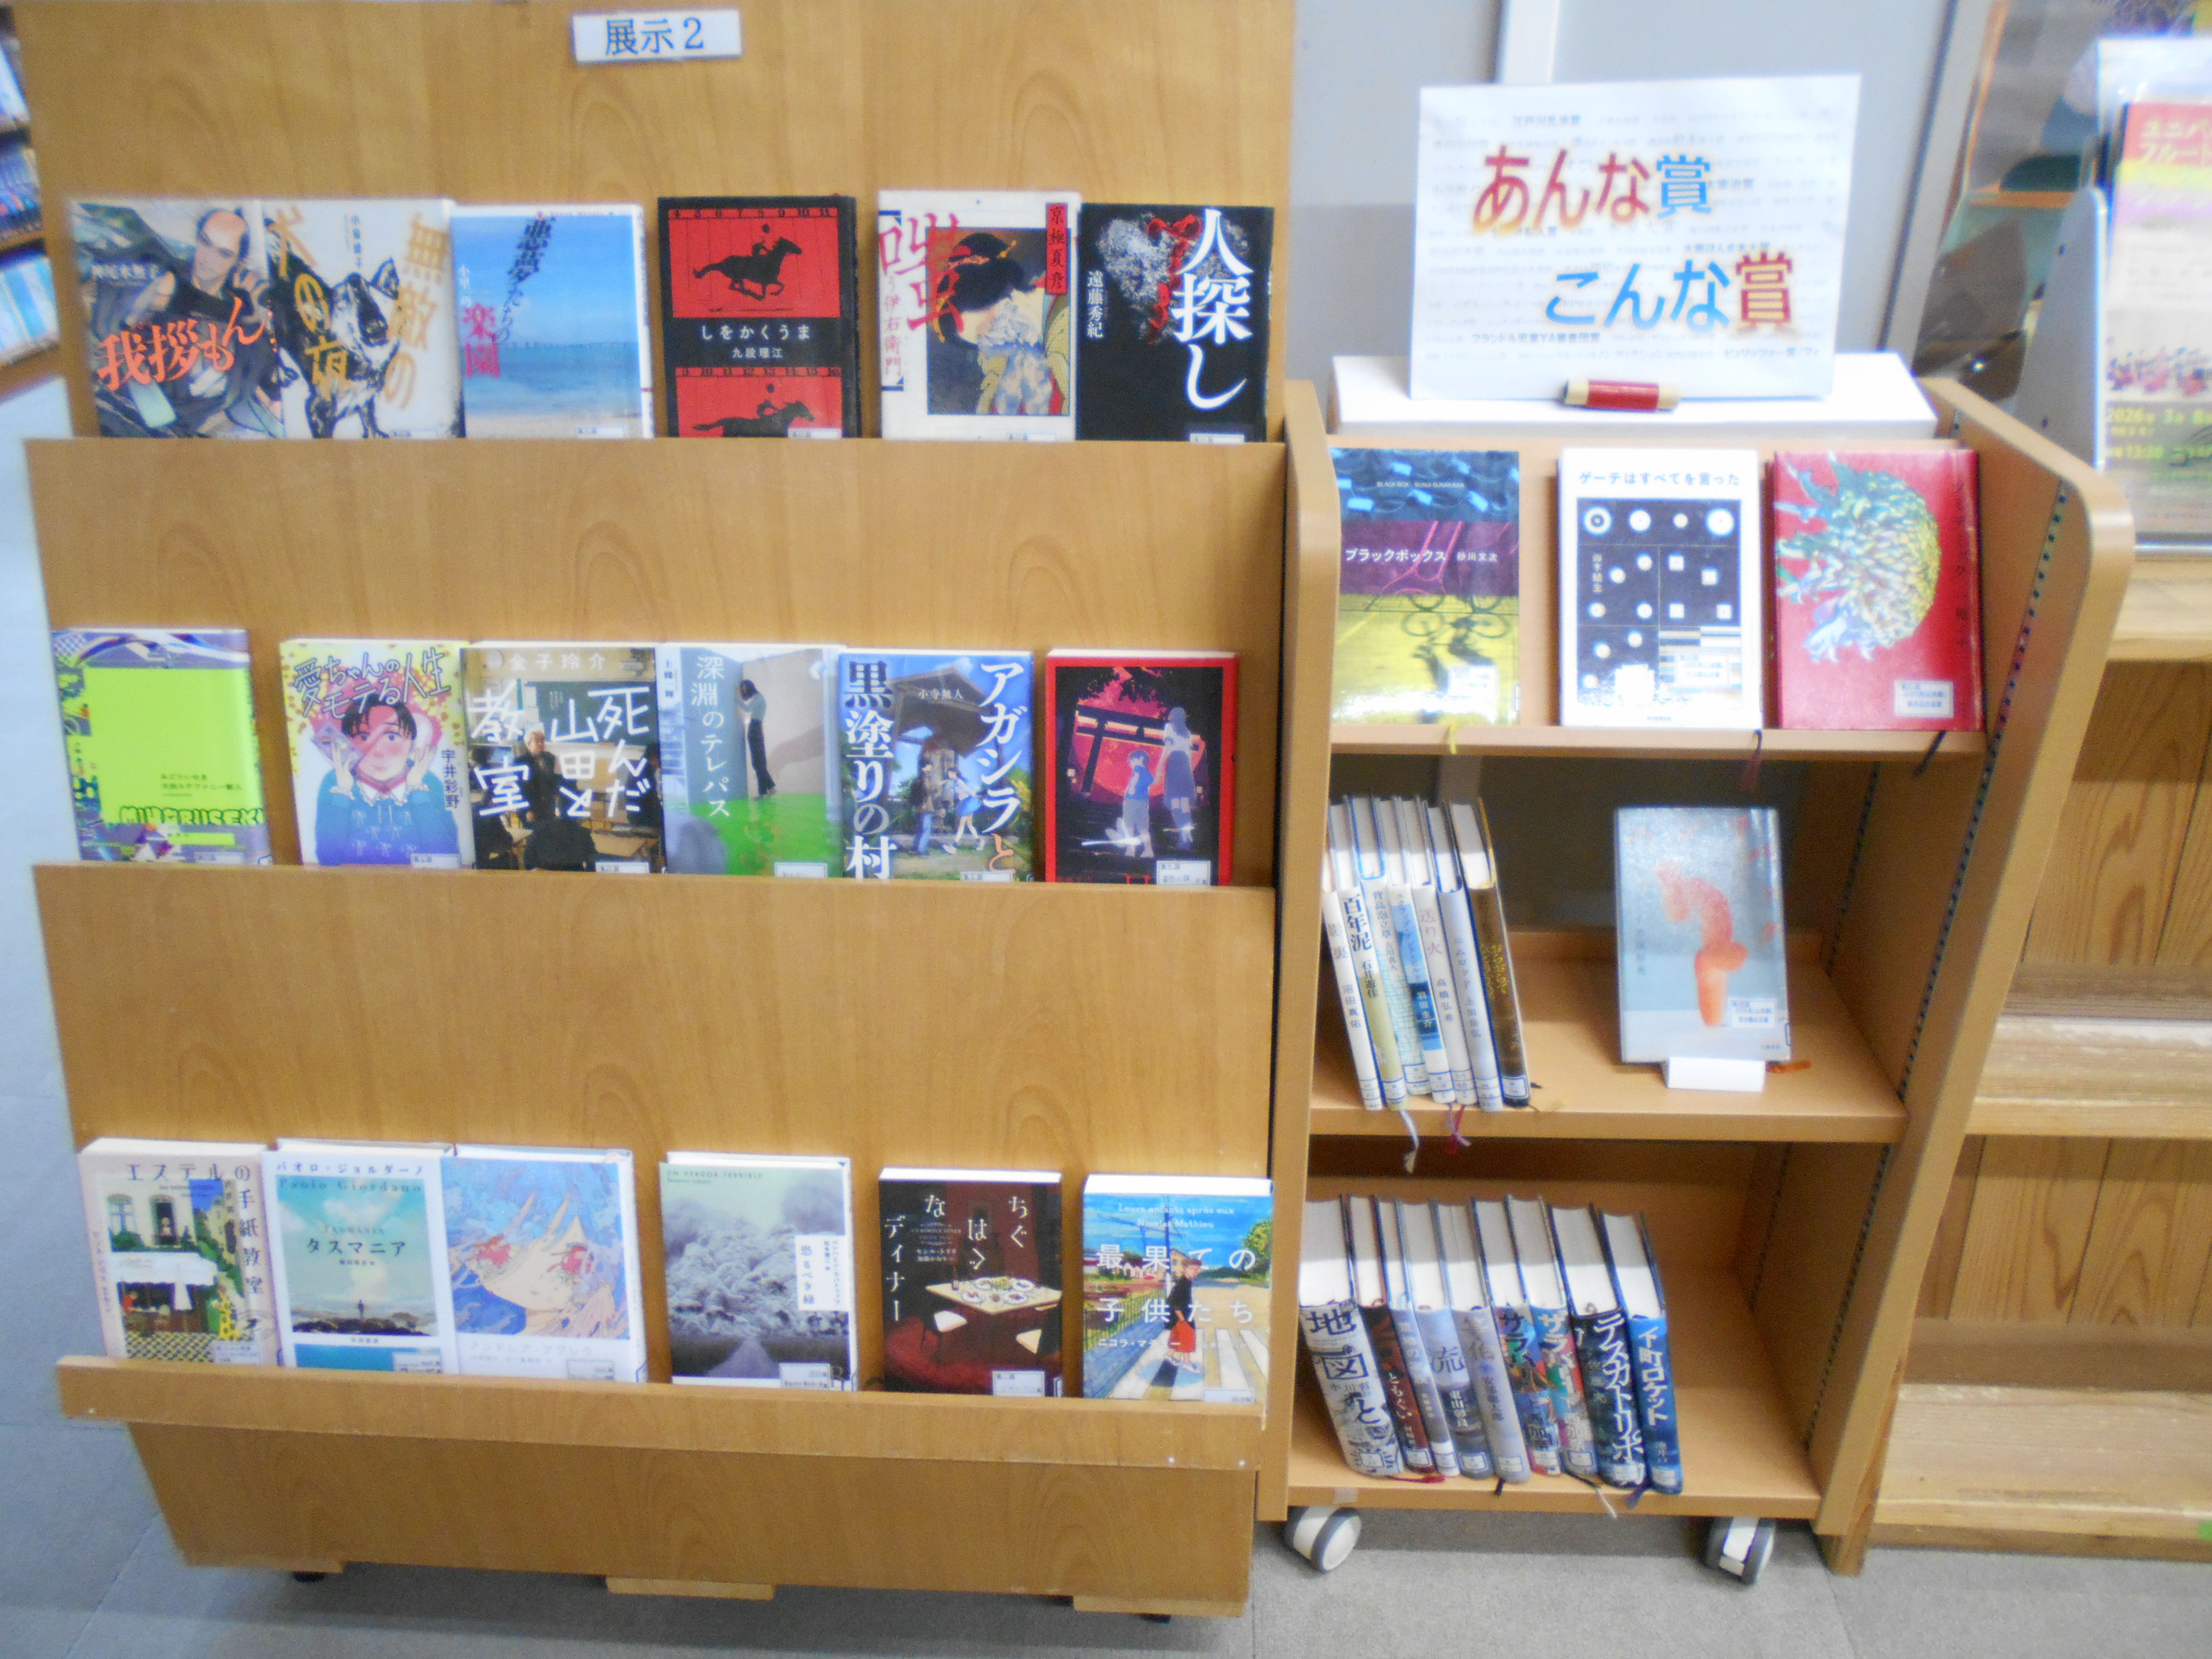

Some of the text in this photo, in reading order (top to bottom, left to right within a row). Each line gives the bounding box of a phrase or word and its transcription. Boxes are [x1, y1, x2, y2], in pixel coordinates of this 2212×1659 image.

[605, 17, 705, 56] 展示2
[1472, 144, 1713, 237] あんな賞
[1086, 271, 1104, 339] 遠藤秀紀
[1171, 208, 1255, 410] 人探し
[1545, 250, 1798, 333] こんな賞
[701, 324, 810, 341] しをかくうま
[732, 347, 783, 359] 九段理江
[1579, 471, 1740, 486] ゲーテはすべてを言った
[1346, 547, 1446, 562] ブラックボックス
[467, 678, 651, 817] 死んだ 山田と 教室
[690, 656, 731, 817] 深淵のテレパス
[844, 660, 898, 879] 黒塗りの村
[975, 662, 1028, 873] アガシラと
[1343, 893, 1373, 952] 百年泥
[1420, 909, 1443, 956] 送り火
[129, 1164, 251, 1181] エステルの
[1118, 1203, 1146, 1213] Leurs
[1175, 1218, 1215, 1229] Mathieu
[307, 1238, 406, 1256] タスマニア
[884, 1215, 906, 1321] ディナー
[1096, 1297, 1253, 1324] 子供たち
[1431, 1346, 1465, 1374] 流
[1638, 1325, 1668, 1426] 下町ロケット
